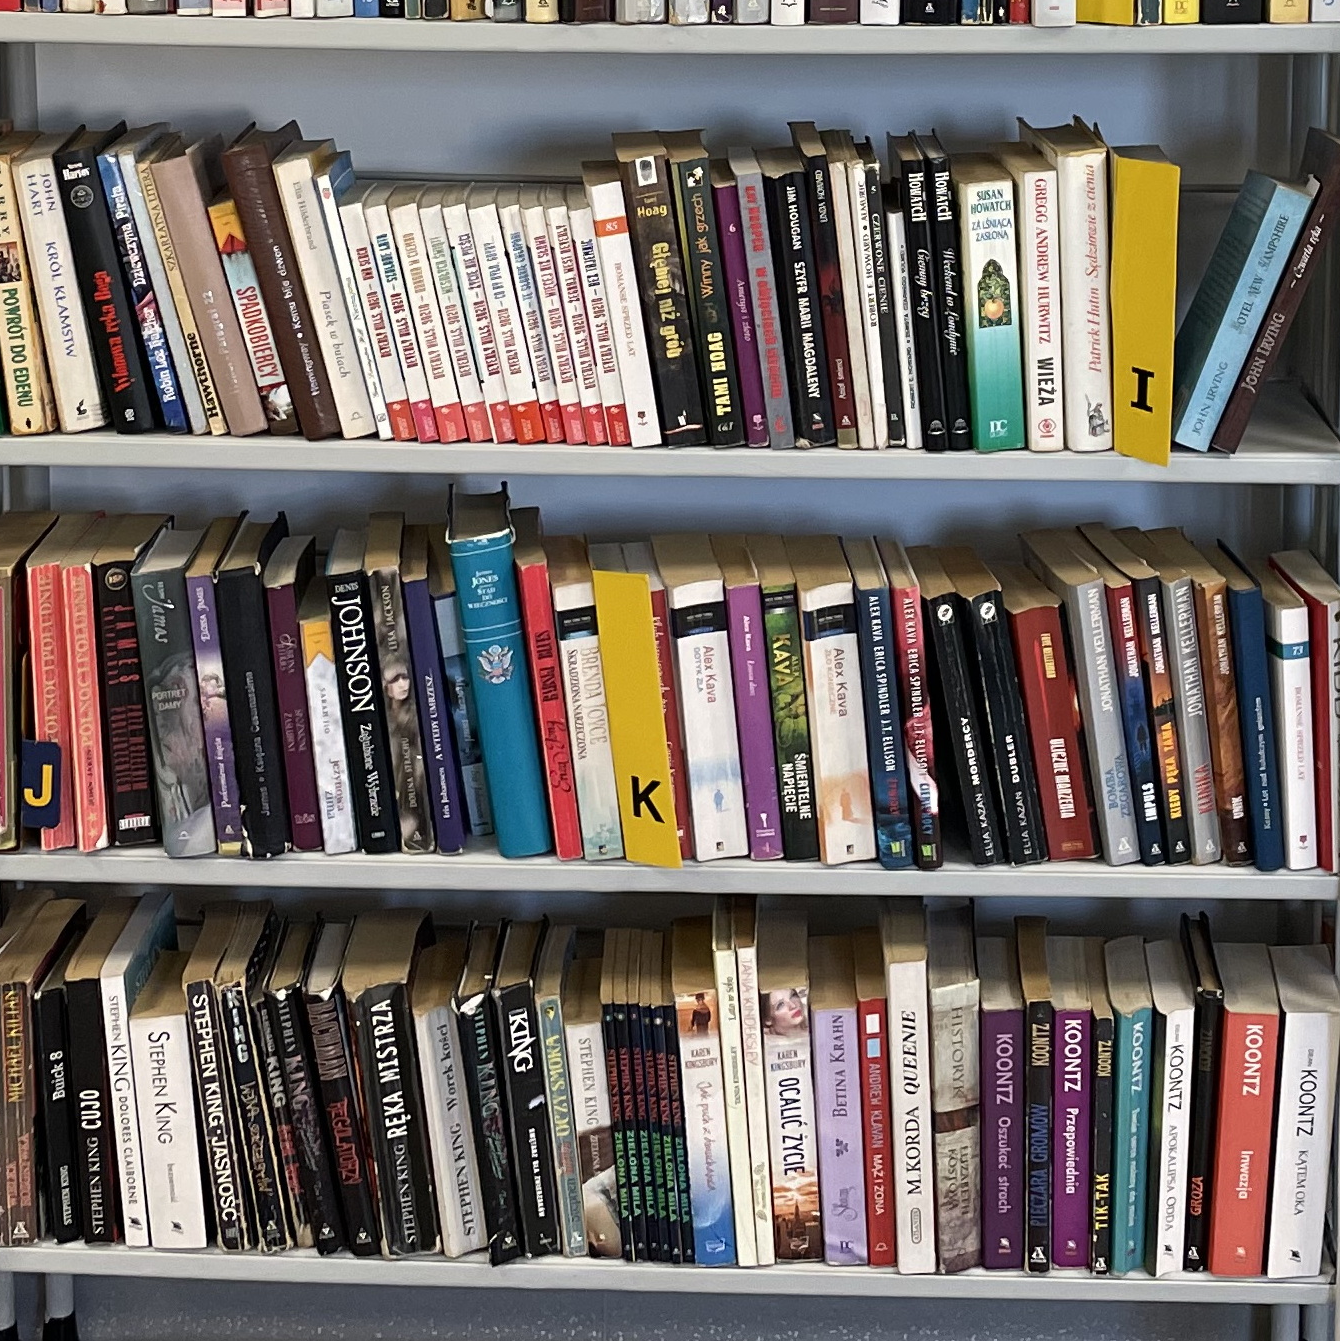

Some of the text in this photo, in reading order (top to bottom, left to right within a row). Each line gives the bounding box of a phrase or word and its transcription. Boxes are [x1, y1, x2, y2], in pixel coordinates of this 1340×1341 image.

[977, 189, 1004, 200] SUSAN
[45, 242, 61, 282] KRÓL
[237, 286, 281, 388] SPADKOBIERCY
[1037, 356, 1055, 408] WIEŻA
[1131, 366, 1155, 412] I
[334, 599, 374, 712] JOHNSON
[702, 646, 717, 704] Alex Kava
[1177, 585, 1204, 716] JONATHAN KELLERMAN
[25, 764, 52, 807] J
[632, 776, 665, 823] K
[783, 763, 797, 813] NAPIĘCIE
[794, 753, 811, 819] ŚMIERTELNE
[1144, 782, 1157, 822] IMPULS
[371, 1000, 410, 1138] RĘKA MISTRZA
[830, 1014, 847, 1118] BETINA KRAHN
[904, 1010, 917, 1095] QUEENIE
[81, 1089, 101, 1130] CUJO
[155, 1101, 172, 1143] KING
[778, 1077, 805, 1177] OCALIĆ ŻYCIE
[1063, 1020, 1082, 1194] KOONTZ Przepowiednia
[1237, 1023, 1263, 1200] KOONTZ Inwazja
[1296, 1068, 1318, 1137] KOONTZ
[1094, 1173, 1109, 1231] TIK-TAK
